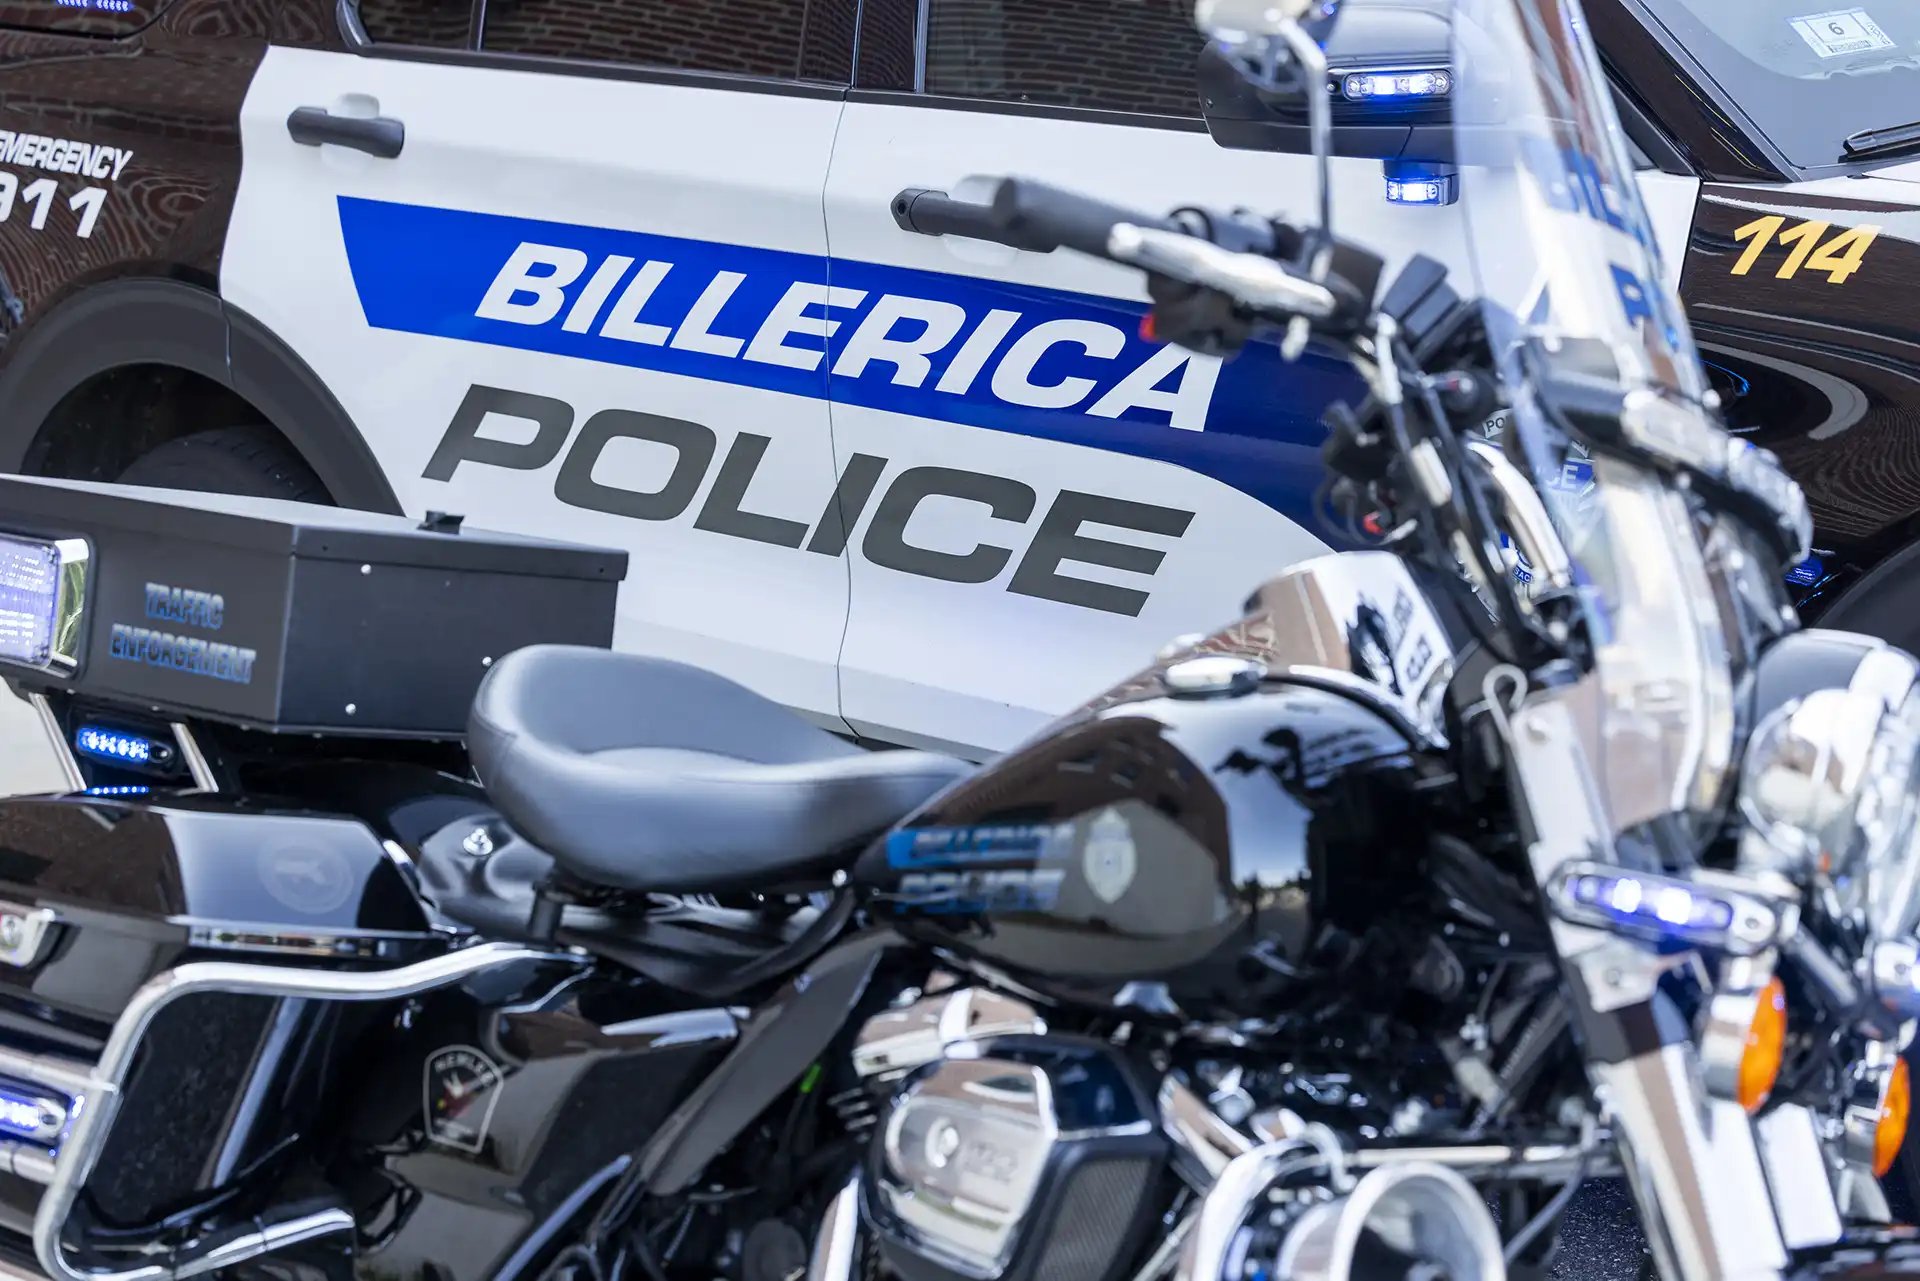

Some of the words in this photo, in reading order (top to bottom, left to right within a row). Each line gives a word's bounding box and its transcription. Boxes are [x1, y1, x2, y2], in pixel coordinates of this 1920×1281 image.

[1828, 22, 1845, 35] 6
[0, 129, 134, 181] EMERGENCY
[1730, 215, 1883, 284] 114
[474, 241, 1224, 432] BILLERICA
[421, 383, 1196, 618] POLICE
[145, 582, 224, 630] TRAFFIC
[110, 623, 256, 684] ENFORCEMENT
